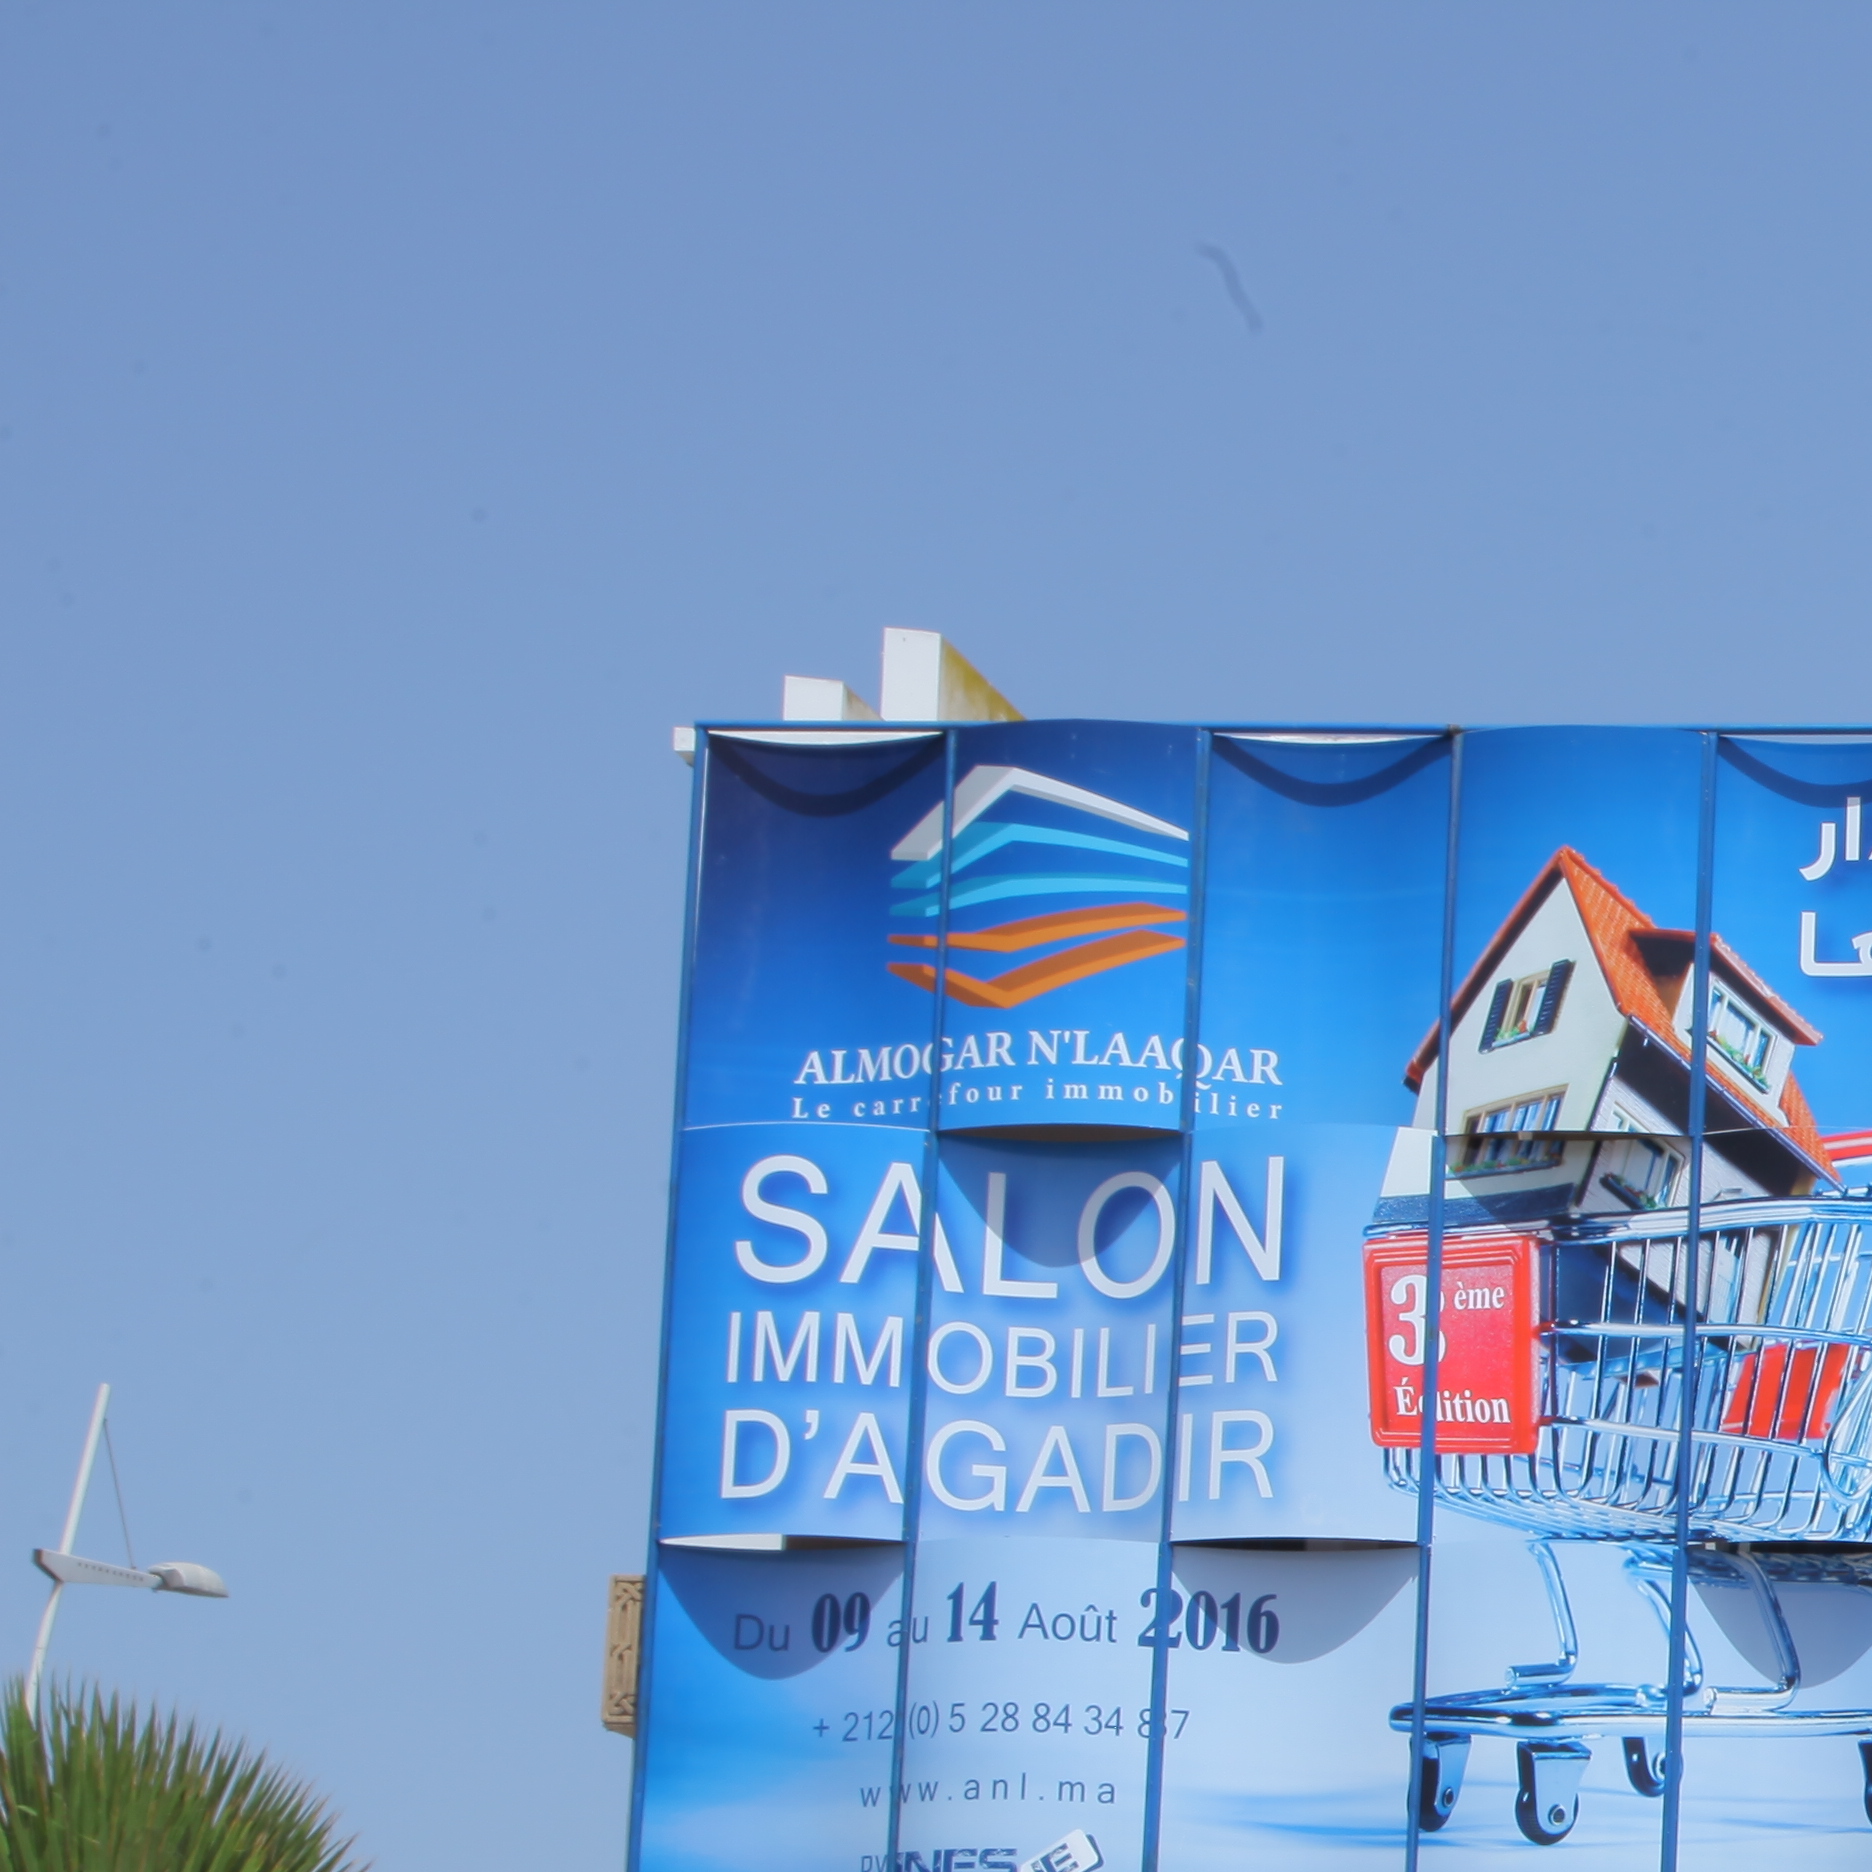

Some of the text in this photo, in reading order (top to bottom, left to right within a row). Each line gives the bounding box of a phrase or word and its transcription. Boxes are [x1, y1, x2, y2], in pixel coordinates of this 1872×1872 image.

[794, 1030, 1283, 1090] ALMOGAR N'LAAQAR
[793, 1079, 1282, 1119] Le carrfour immobilier
[735, 1155, 1284, 1300] SALON
[1453, 1282, 1505, 1310] ème
[726, 1310, 1279, 1399] IMMOBILIER
[720, 1408, 1276, 1514] D'AGADIR
[734, 1581, 1280, 1654] Du 09 au 14 Août 2016
[842, 1701, 1191, 1742] 212 (0) 5 28 84 34 87
